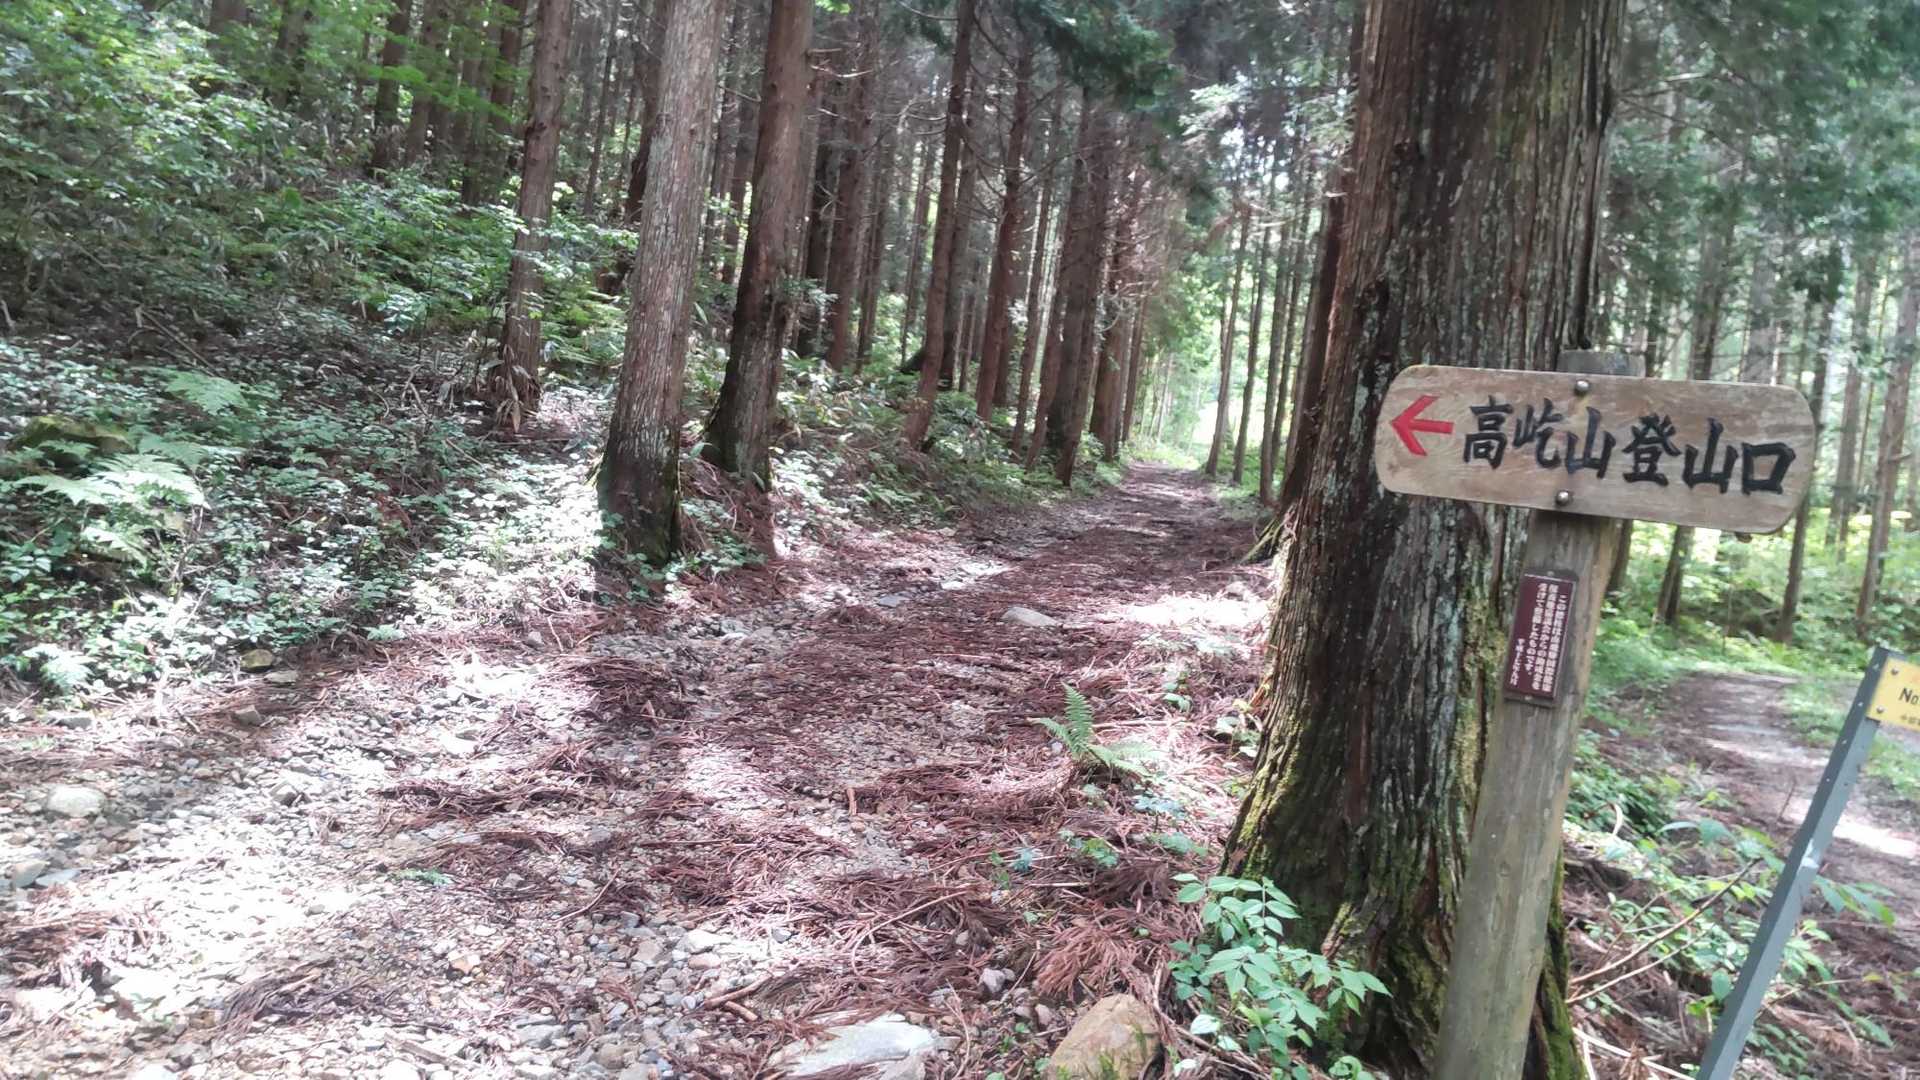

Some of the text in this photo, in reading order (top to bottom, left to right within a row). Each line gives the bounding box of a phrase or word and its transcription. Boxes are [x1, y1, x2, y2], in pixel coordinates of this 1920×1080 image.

[1462, 394, 1796, 494] 高屹山登山口
